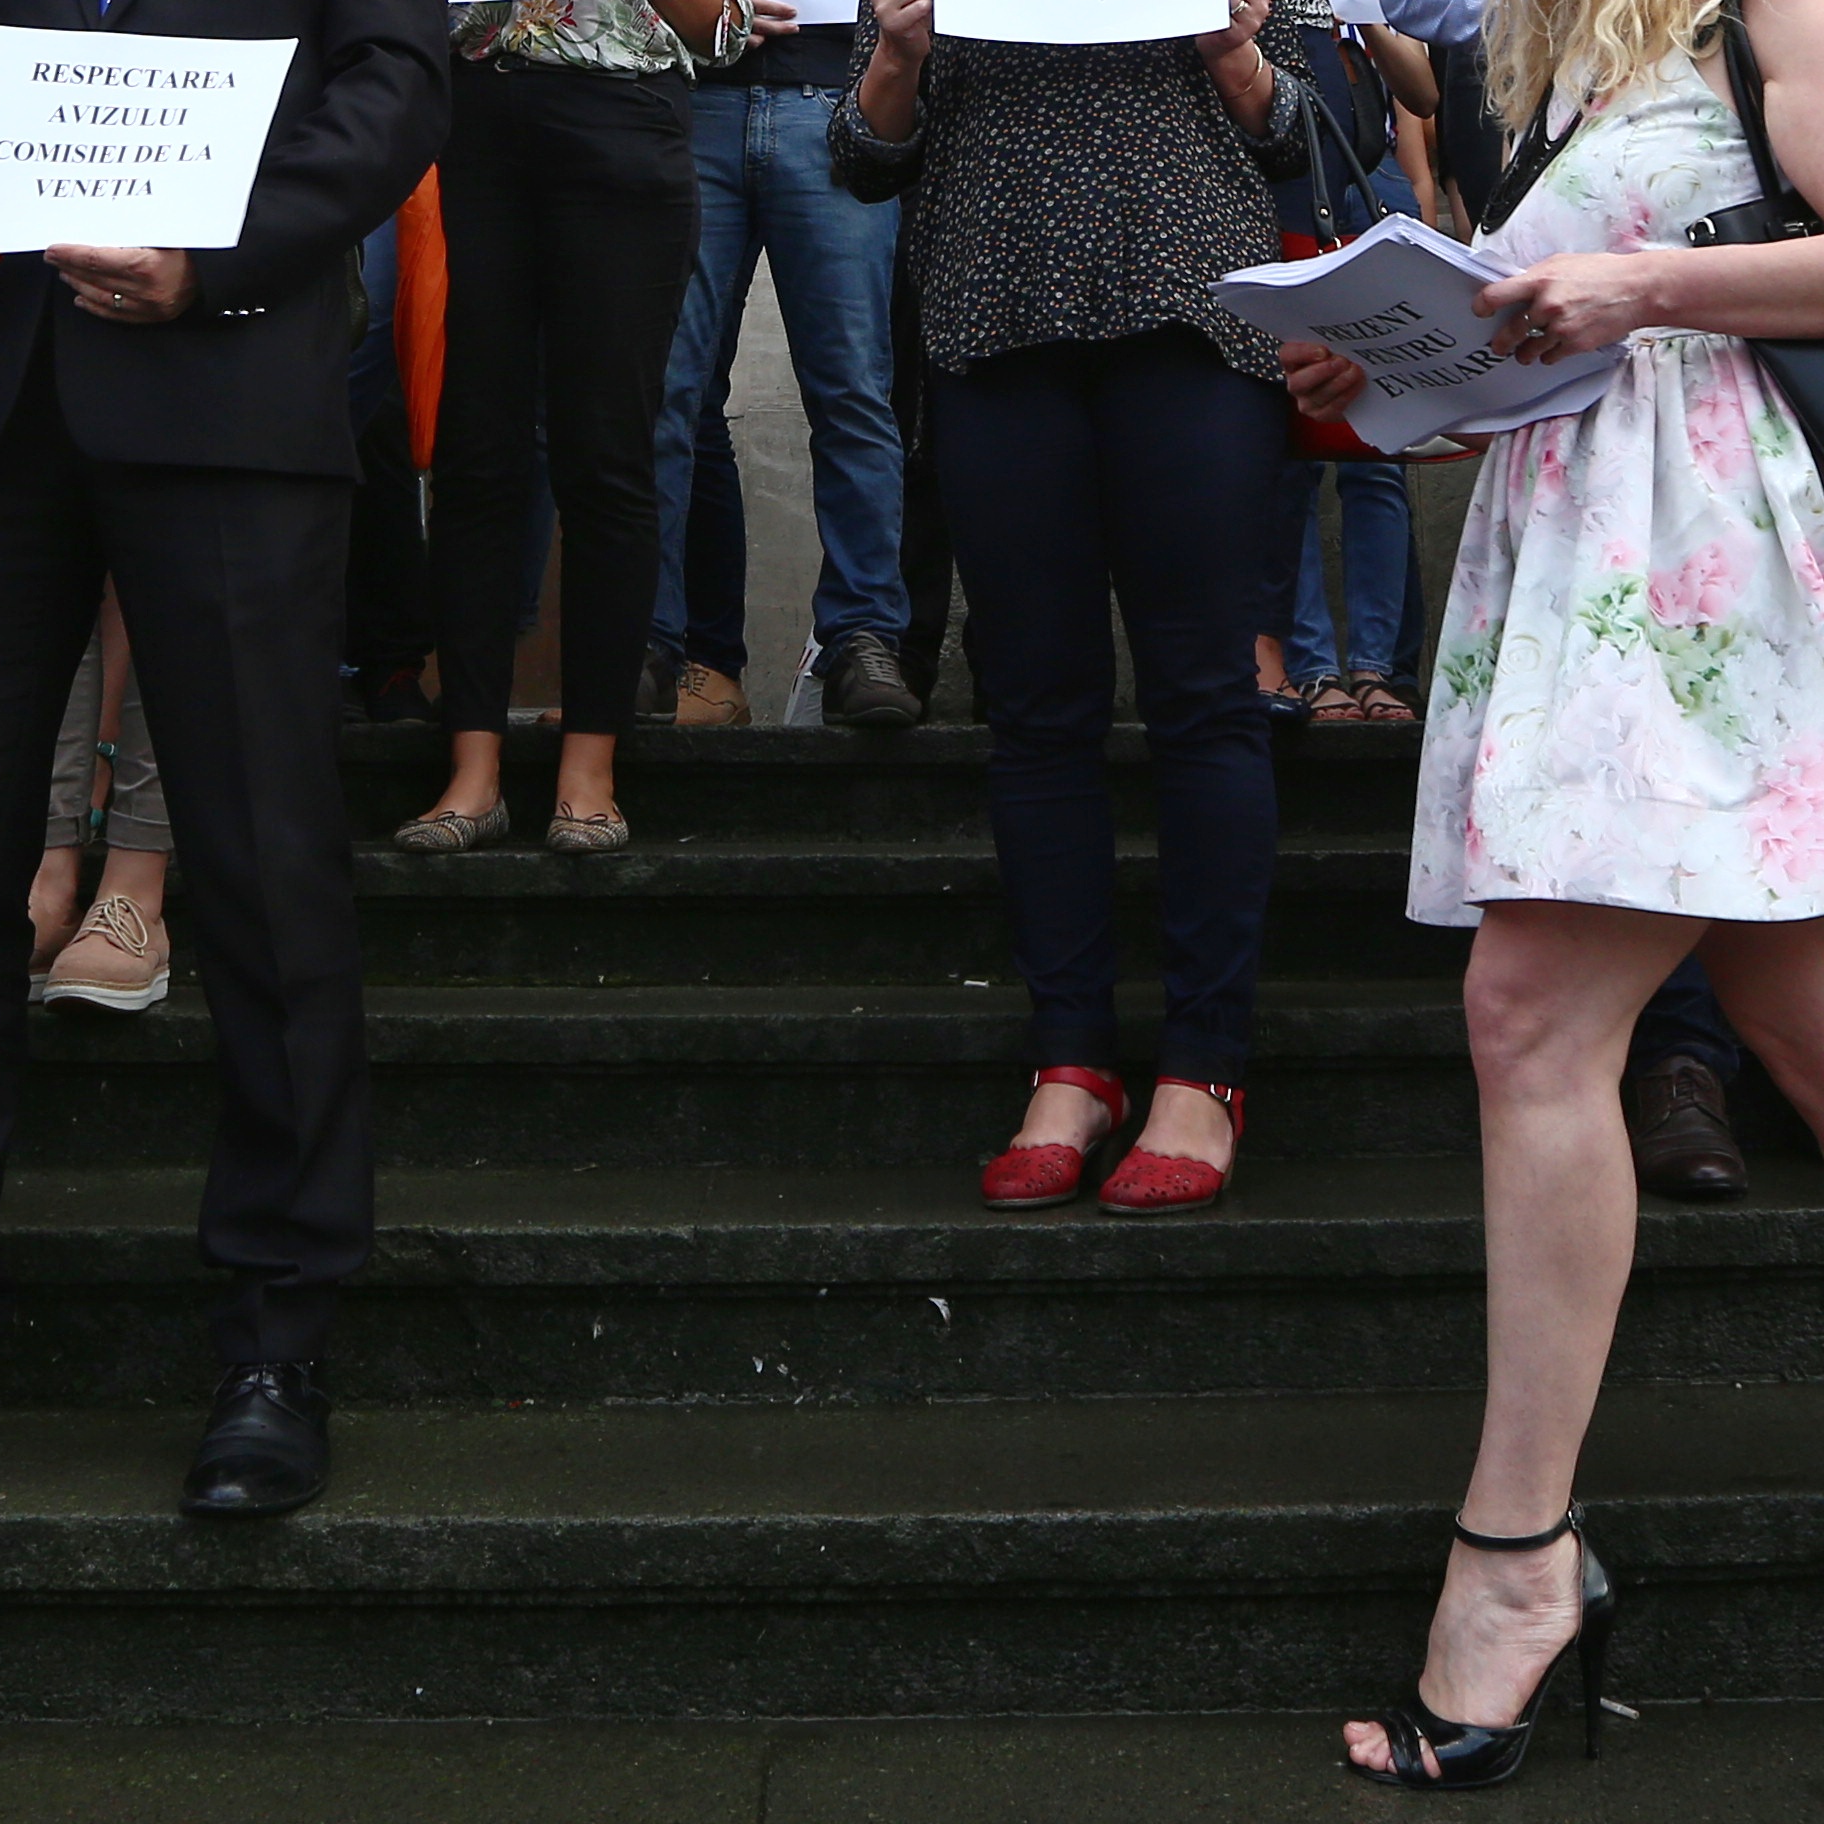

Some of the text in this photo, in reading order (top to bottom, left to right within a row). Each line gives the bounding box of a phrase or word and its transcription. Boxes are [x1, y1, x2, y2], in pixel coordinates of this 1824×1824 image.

[30, 62, 236, 89] RESPECTAREA
[47, 104, 189, 127] AVIZULUI
[133, 144, 171, 163] DE
[177, 144, 212, 162] LA
[36, 178, 153, 201] VENEȚIA
[1309, 300, 1425, 343] PREZENT
[1353, 328, 1458, 366] PENTRU
